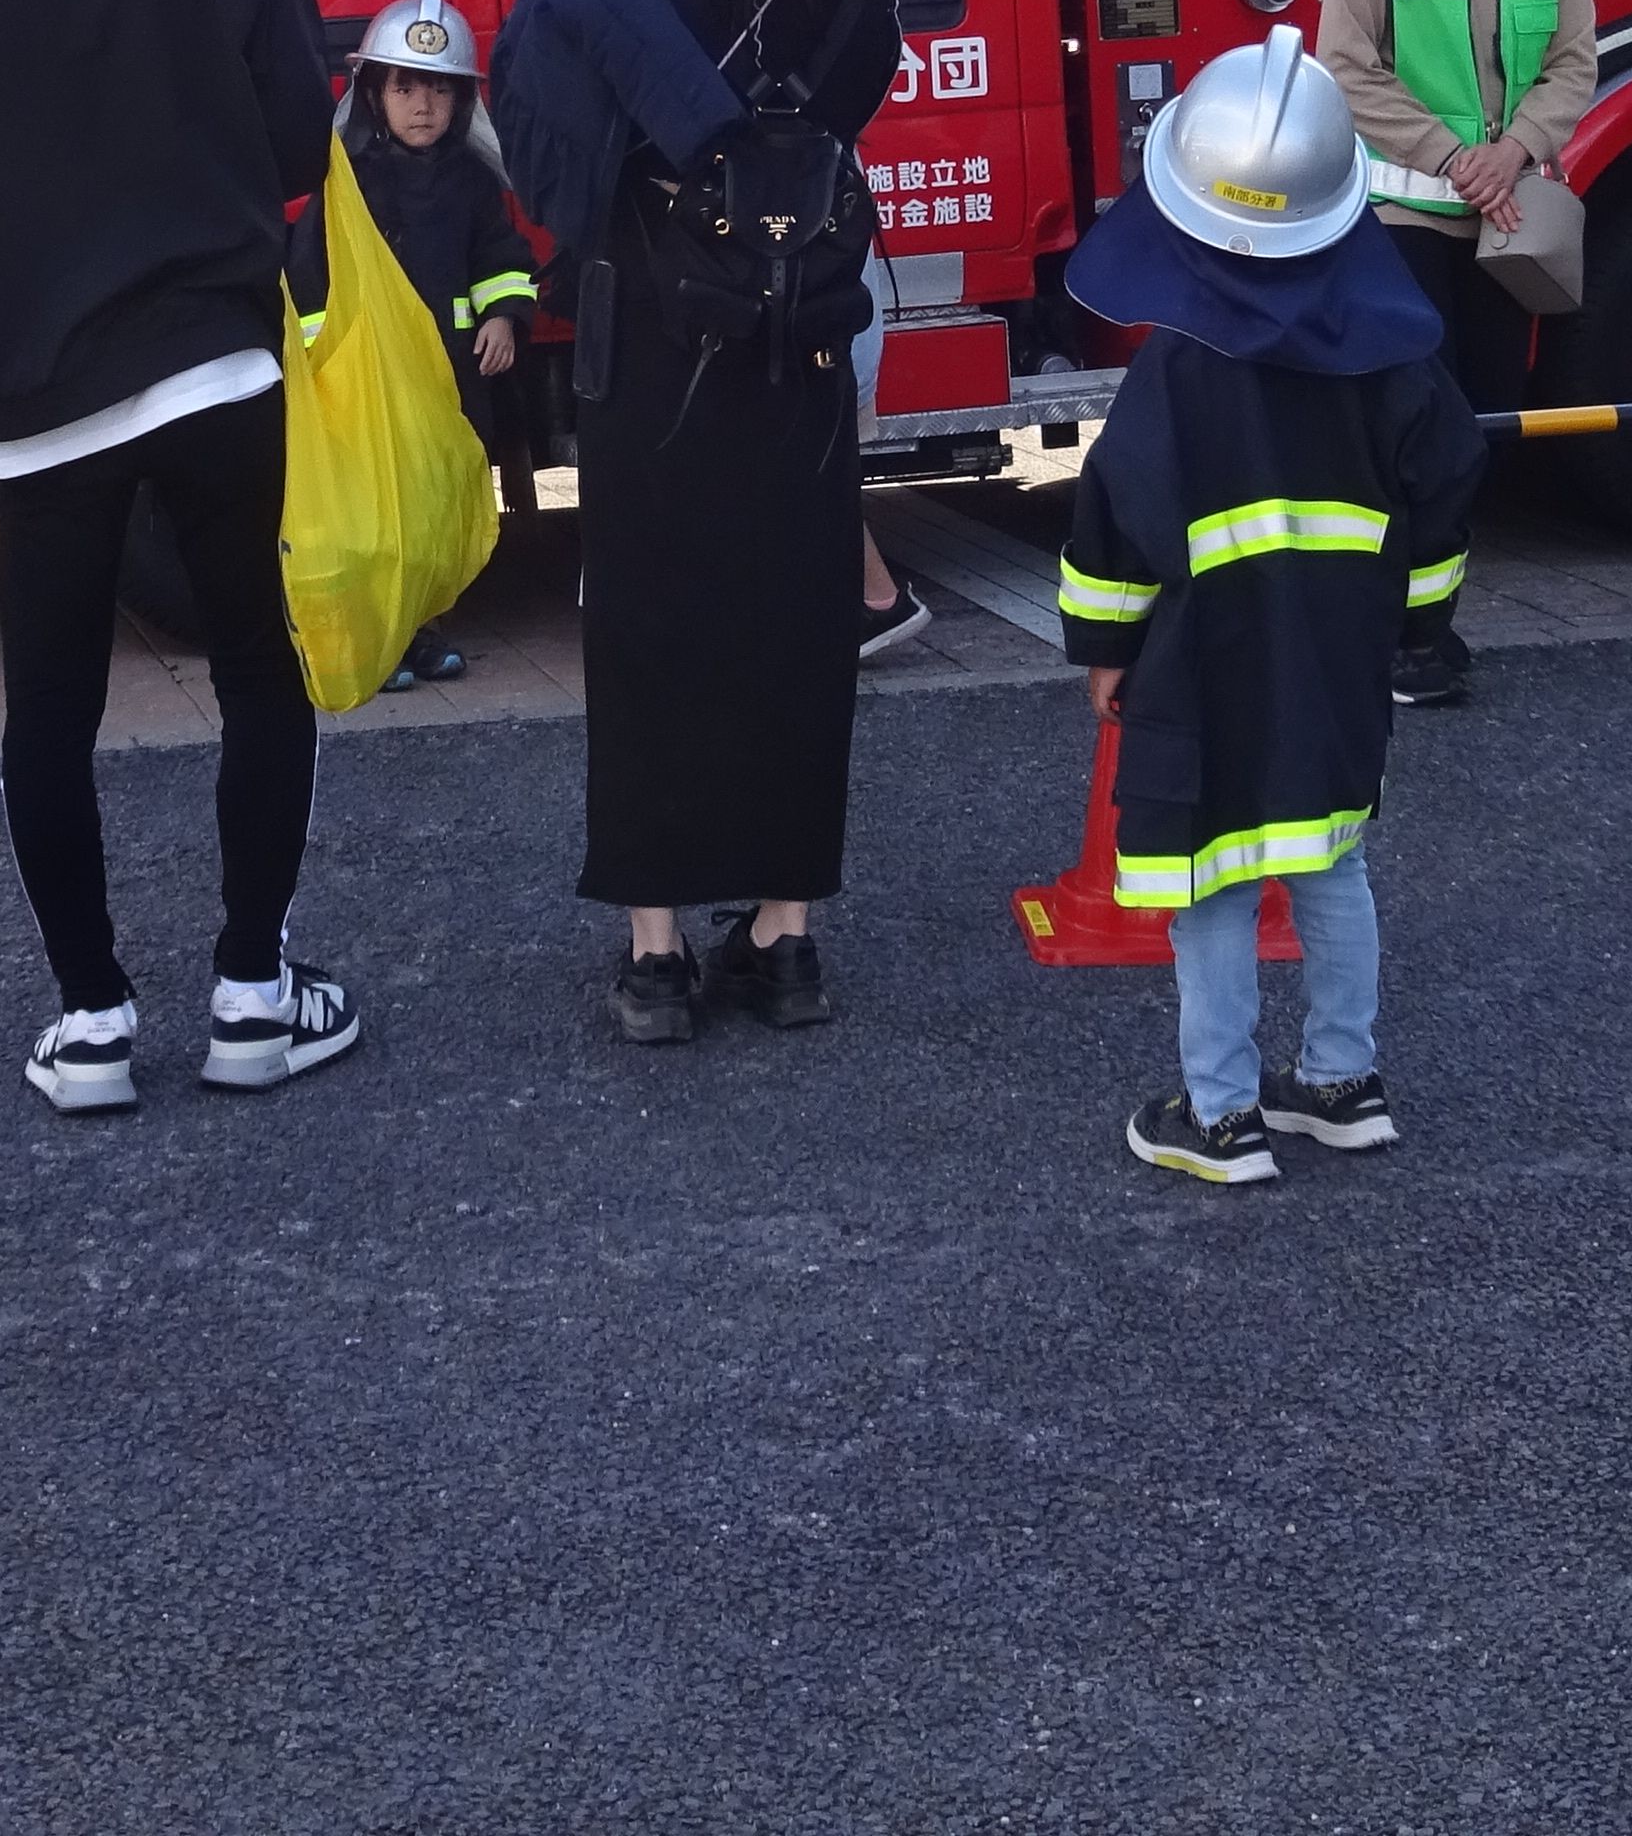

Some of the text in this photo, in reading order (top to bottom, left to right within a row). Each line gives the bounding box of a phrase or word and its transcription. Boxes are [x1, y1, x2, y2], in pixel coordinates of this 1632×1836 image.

[865, 155, 991, 194] 施設立地
[1222, 184, 1278, 208] 南部分署
